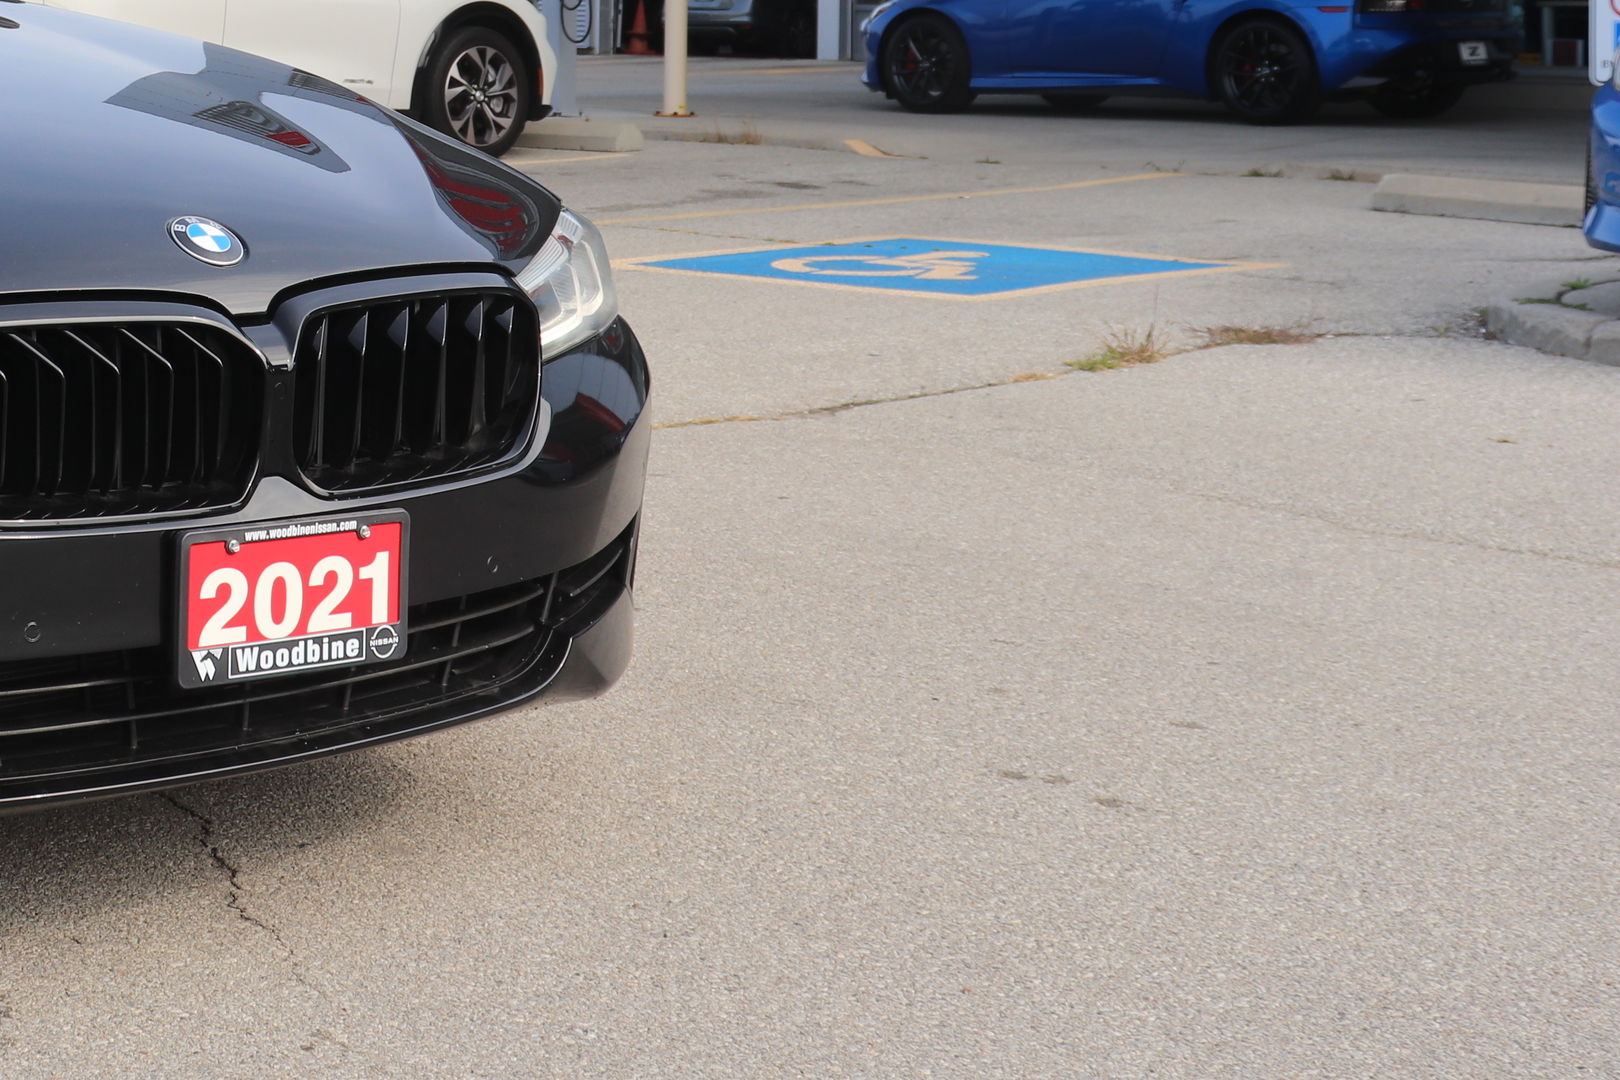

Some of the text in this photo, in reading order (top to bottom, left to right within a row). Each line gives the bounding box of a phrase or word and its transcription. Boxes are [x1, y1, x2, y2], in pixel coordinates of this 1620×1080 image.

[174, 217, 222, 232] BMW
[244, 520, 357, 541] www.woodbinenissan.com
[198, 550, 390, 648] 2021
[369, 636, 399, 647] NISSAN
[235, 637, 361, 672] Woodbine
